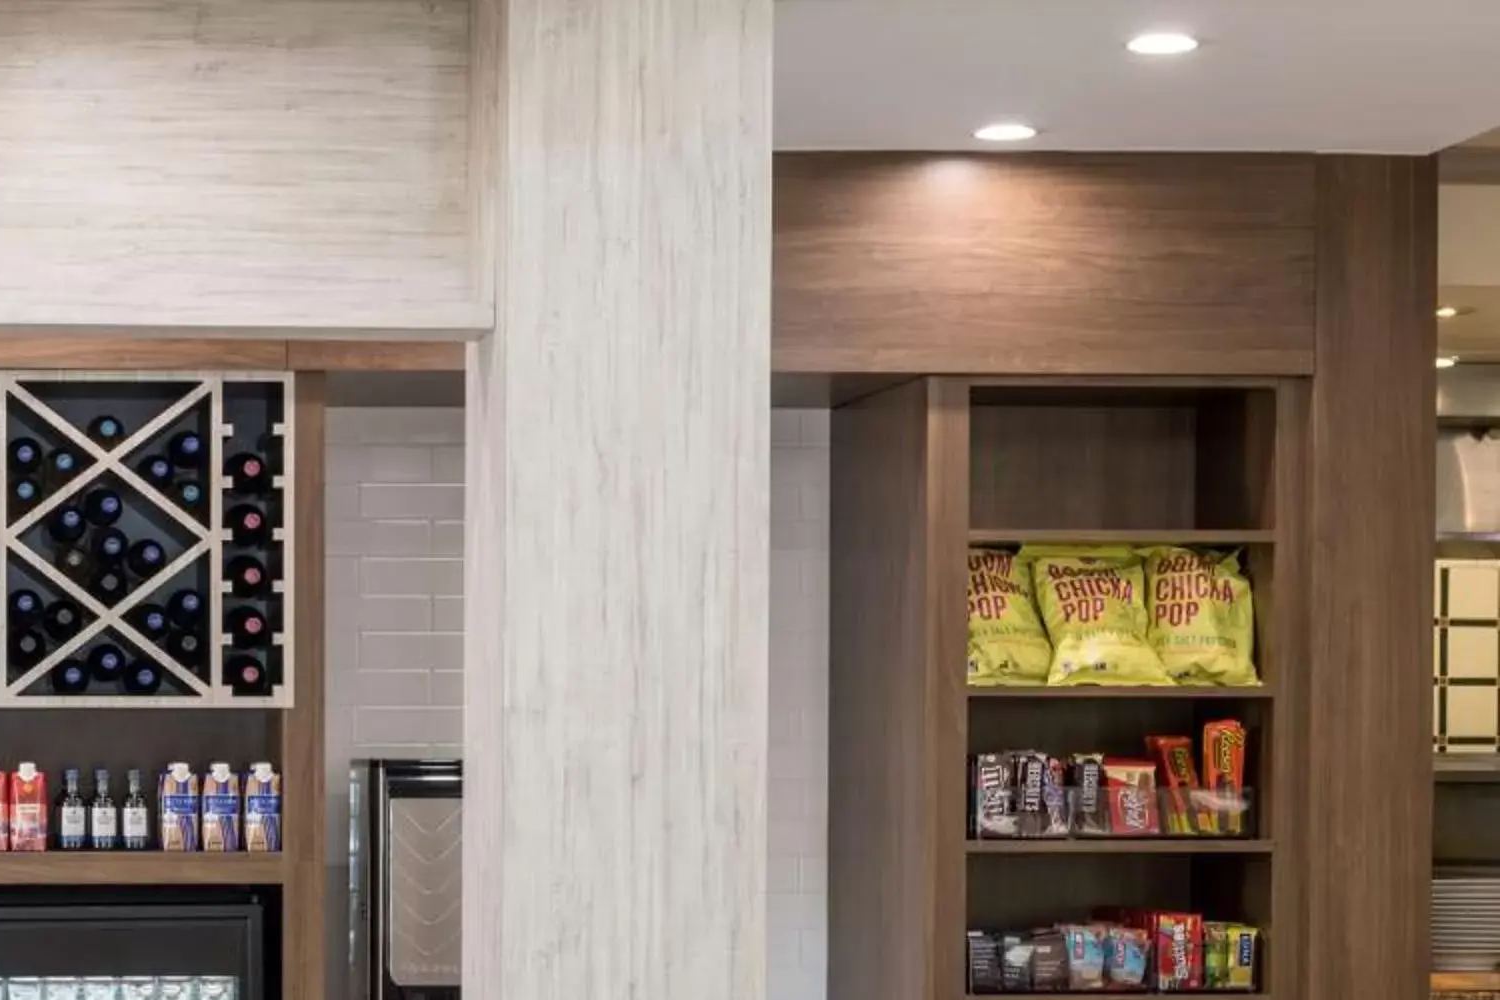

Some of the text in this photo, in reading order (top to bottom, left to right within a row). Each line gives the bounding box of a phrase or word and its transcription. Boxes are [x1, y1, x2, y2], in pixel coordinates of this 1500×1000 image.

[1055, 575, 1133, 606] CHICKA
[1155, 573, 1234, 604] CHICKA
[1062, 598, 1105, 624] POP
[1155, 601, 1199, 628] POP
